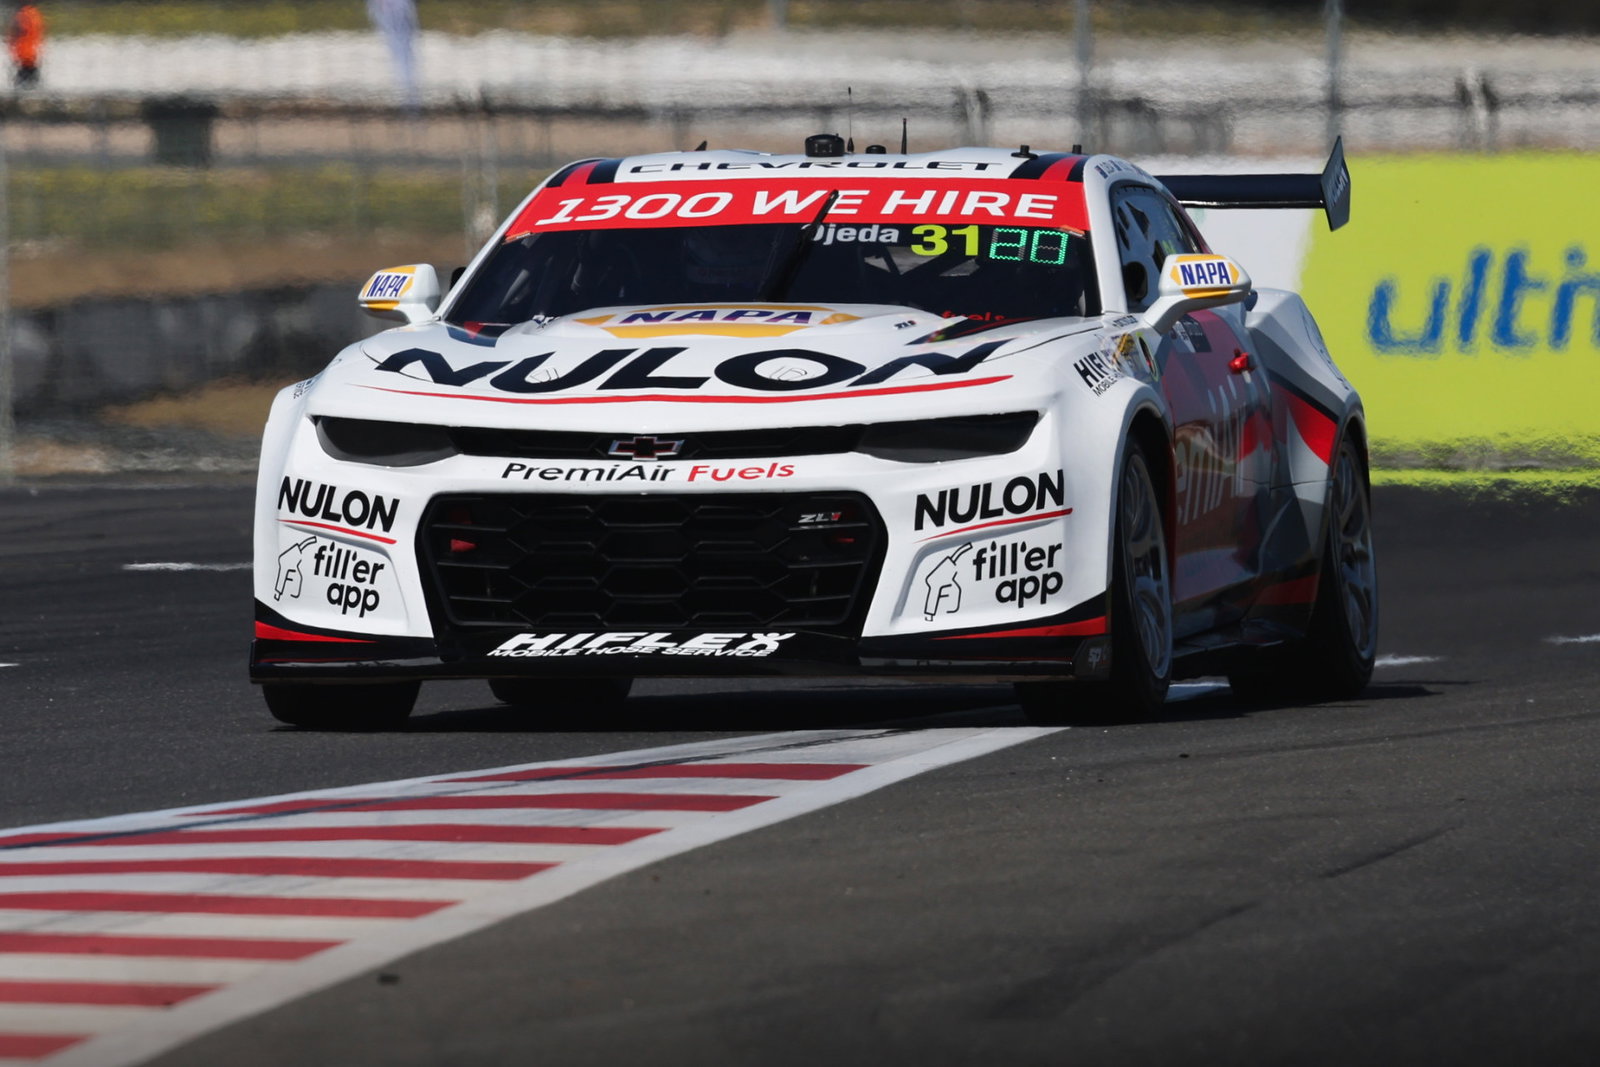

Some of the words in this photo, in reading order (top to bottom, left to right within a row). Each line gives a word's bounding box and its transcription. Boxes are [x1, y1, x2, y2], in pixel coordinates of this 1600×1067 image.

[629, 160, 1002, 174] CHEVROLET
[535, 192, 734, 225] 1300
[752, 189, 870, 217] WE
[880, 189, 1058, 219] HIRE
[911, 224, 979, 256] 31
[988, 227, 1069, 265] 20
[366, 274, 409, 298] NAPA
[1180, 261, 1232, 286] NAPA
[1366, 244, 1600, 358] ulti
[618, 309, 814, 326] NAPA
[374, 337, 1015, 393] NULON
[501, 462, 676, 482] PremiAir
[687, 462, 795, 482] Fuels
[277, 475, 400, 533] NULON
[913, 469, 1065, 531] NULON
[798, 511, 842, 524] ZL1
[326, 582, 380, 618] app
[994, 567, 1064, 608] app
[487, 648, 581, 657] MOBILE
[584, 646, 658, 655] HOSE
[661, 646, 774, 657] SERVICE
[496, 632, 796, 651] HIFLEX
